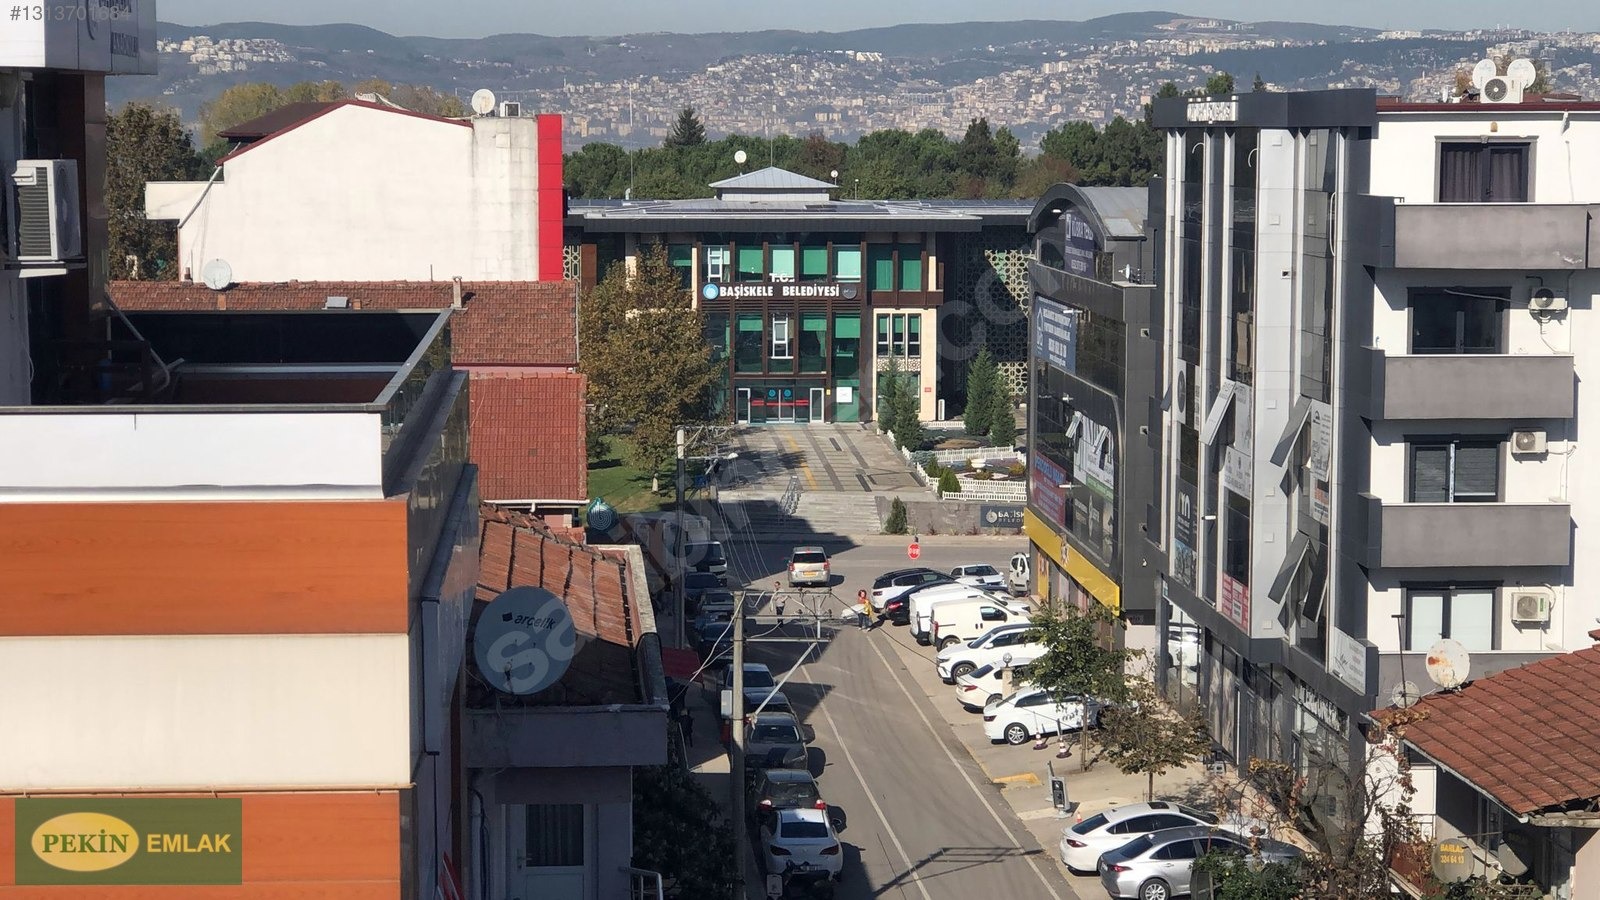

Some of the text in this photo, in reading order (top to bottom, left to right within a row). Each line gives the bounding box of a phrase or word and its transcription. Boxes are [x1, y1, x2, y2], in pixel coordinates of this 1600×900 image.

[719, 283, 840, 299] BAŞİSKELE BELEDİYESİ
[514, 614, 556, 630] arçelik
